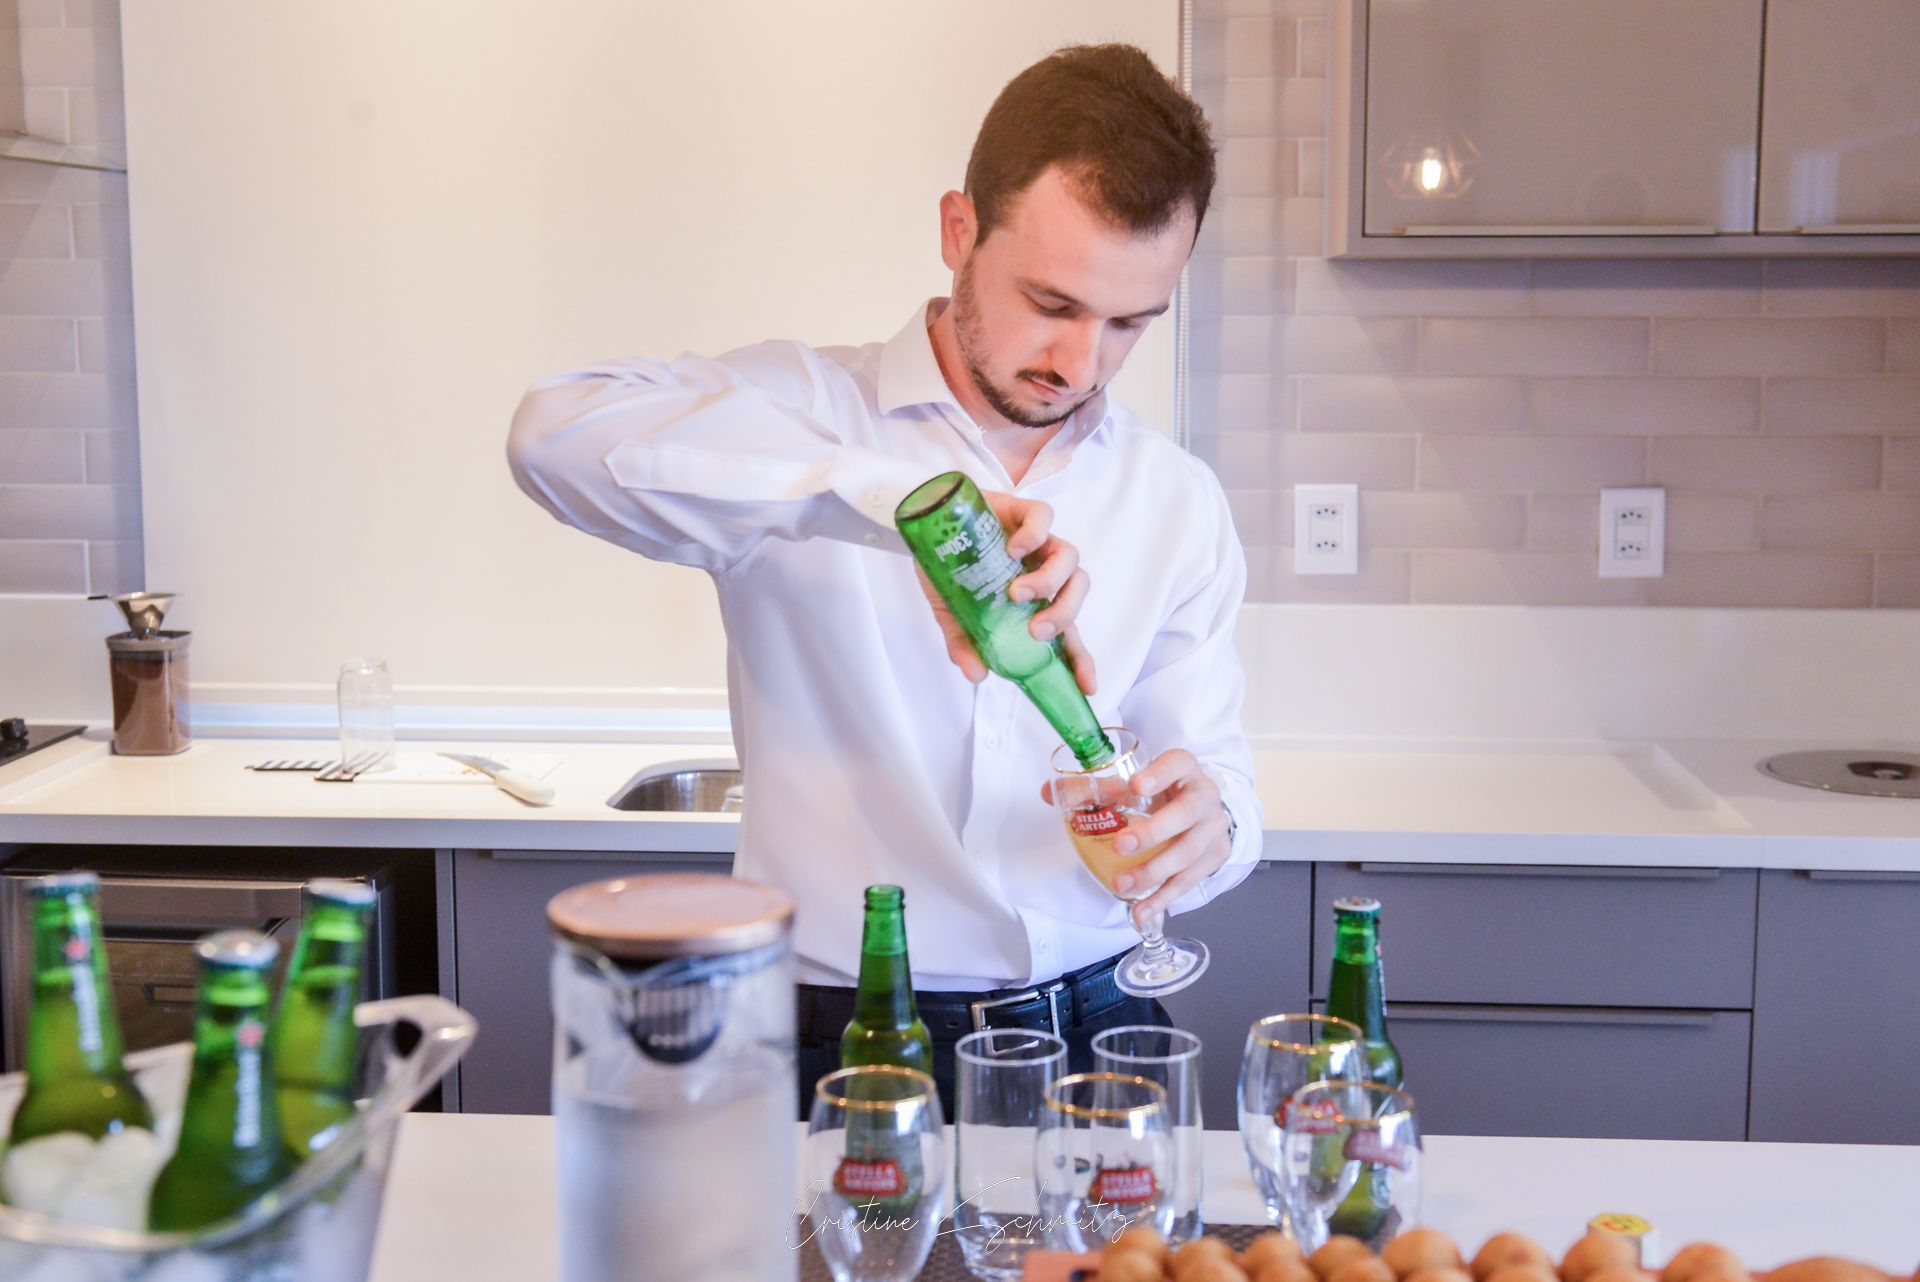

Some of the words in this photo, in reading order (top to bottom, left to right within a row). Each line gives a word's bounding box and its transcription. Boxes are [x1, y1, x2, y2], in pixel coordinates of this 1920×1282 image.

[934, 531, 973, 562] 330ml
[1076, 811, 1114, 823] STELLA
[1078, 819, 1118, 832] ARTOIS
